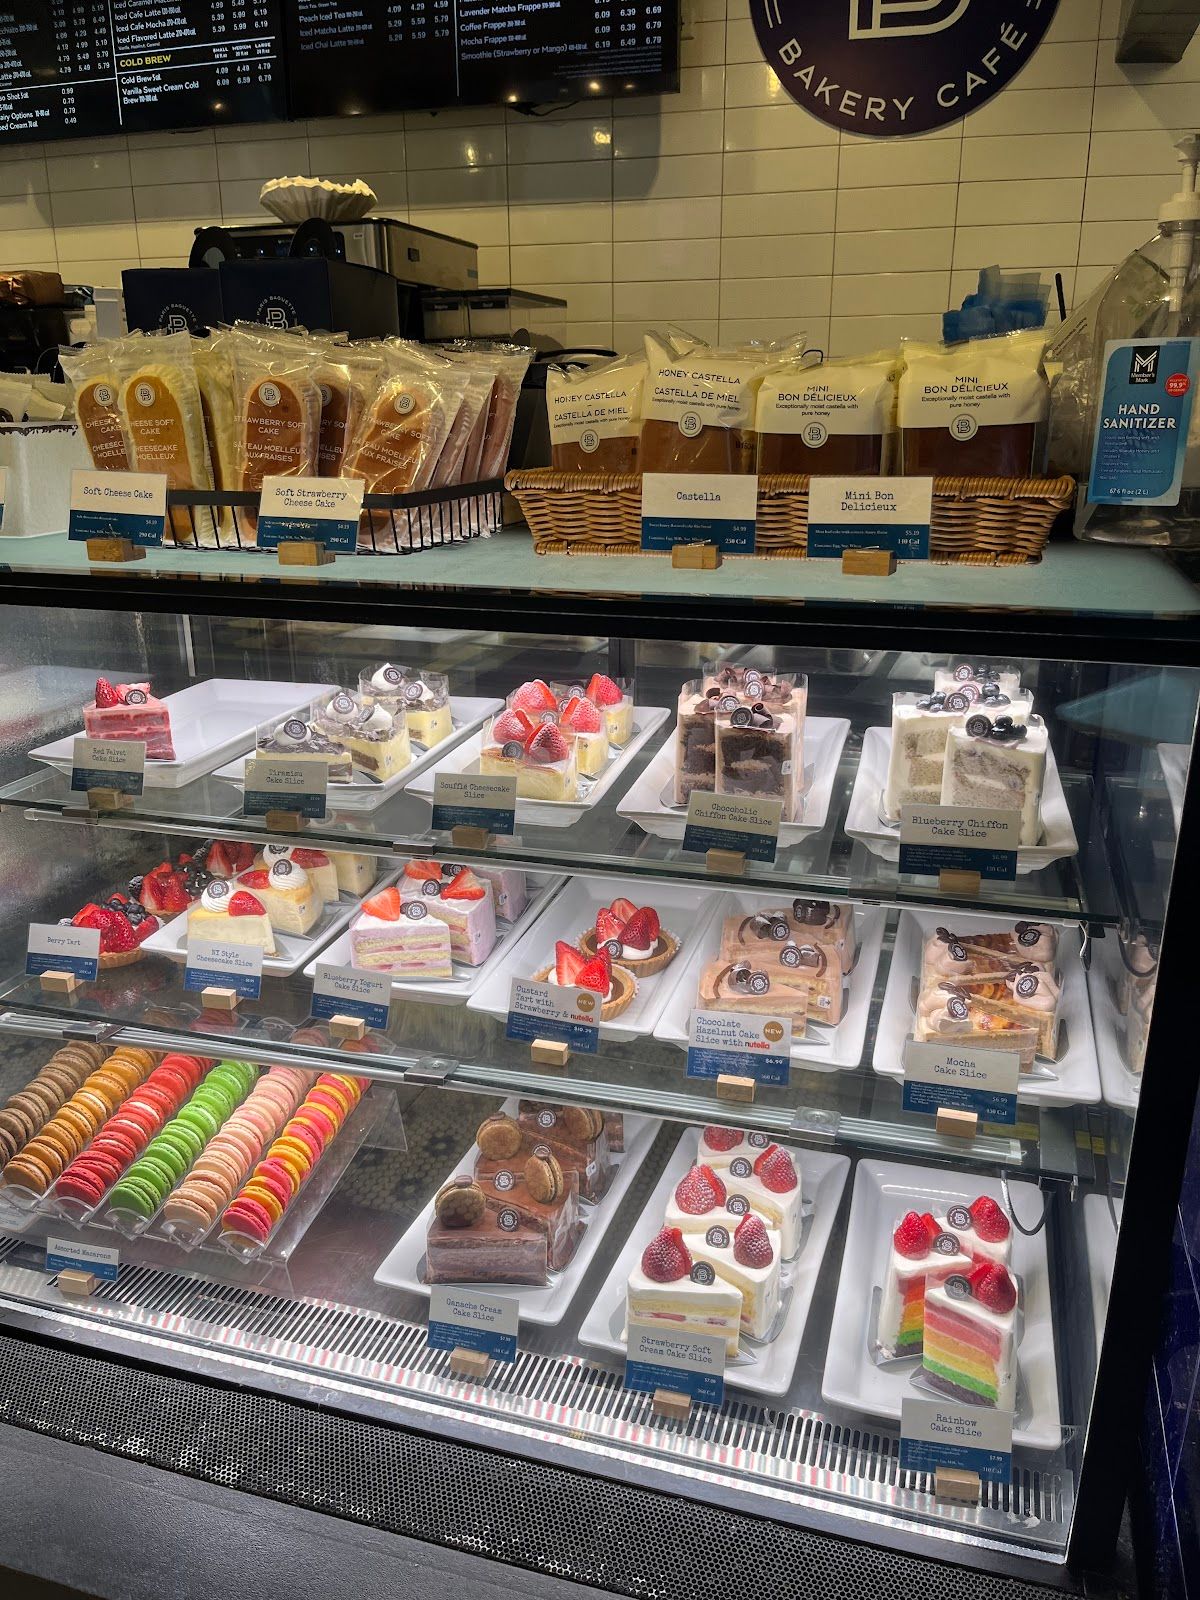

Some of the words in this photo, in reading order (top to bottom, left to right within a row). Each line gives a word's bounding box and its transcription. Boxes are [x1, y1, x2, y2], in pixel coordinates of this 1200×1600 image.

[115, 12, 127, 20] Iced
[144, 10, 161, 18] Latte
[460, 8, 490, 18] Lavender
[492, 5, 516, 14] Matcha
[518, 4, 540, 13] Frappe
[594, 11, 610, 19] 6.09
[620, 8, 636, 16] 6.39
[646, 6, 661, 14] 6.69
[116, 24, 128, 32] Iced
[146, 20, 166, 28] Mocha
[460, 22, 482, 32] Coffee
[484, 21, 506, 30] Frappe
[595, 26, 610, 34] 6.09
[620, 24, 636, 32] 6.39
[646, 22, 661, 30] 6.79
[117, 36, 130, 44] Iced
[132, 32, 157, 42] Flavored
[158, 32, 176, 40] Latte
[460, 38, 482, 46] Mocha
[484, 36, 508, 44] Frappe
[595, 40, 610, 48] 6.19
[620, 38, 636, 46] 6.49
[646, 36, 661, 44] 6.79
[461, 51, 492, 60] Smoothie
[494, 48, 531, 58] (Strawberry
[542, 44, 568, 54] Mango)
[120, 58, 144, 67] COLD
[145, 54, 172, 65] BREW
[778, 38, 914, 121] BAKERY
[936, 22, 1028, 108] CAFÉ
[121, 76, 135, 84] Cold
[136, 75, 152, 83] Brew
[122, 86, 142, 96] Vanilla
[143, 86, 162, 94] Sweet
[164, 84, 184, 92] Cream
[184, 81, 199, 90] Cold
[123, 96, 138, 104] Brew
[659, 369, 690, 378] HONEY
[691, 372, 741, 385] CASTELLA
[955, 376, 978, 384] MINI
[924, 386, 948, 394] BON
[952, 382, 1008, 393] DÉLICIEUX
[554, 394, 582, 404] HONEY
[584, 391, 627, 401] CASTELLA
[654, 388, 698, 398] CASTELLA
[701, 392, 714, 400] DE
[717, 394, 740, 403] MIEL
[803, 392, 857, 402] DÉLICIEUX
[554, 411, 592, 421] CASTELLA
[608, 406, 628, 415] MIEL
[1118, 403, 1160, 414] HAND
[155, 418, 174, 426] SOFT
[234, 415, 286, 427] STRAWBERRY
[287, 421, 307, 430] SOFT
[1103, 418, 1176, 428] SANITIZER
[258, 427, 280, 435] CAKE
[264, 444, 306, 456] MOELLEUX
[83, 486, 102, 496] Soft
[104, 488, 131, 497] Cheese
[134, 490, 153, 499] Cake
[276, 488, 295, 496] Soft
[296, 489, 348, 500] Strawberry
[676, 492, 721, 501] Castella
[845, 491, 872, 500] Mini
[875, 491, 894, 500] Bon
[284, 498, 312, 507] Cheese
[316, 500, 336, 508] Cake
[841, 502, 897, 511] Delicieux
[441, 782, 467, 790] Souffle
[470, 784, 510, 792] Cheesecake
[712, 804, 758, 816] Chocoholic
[695, 809, 726, 820] Chiffon
[729, 814, 747, 822] Cake
[749, 817, 772, 825] Slice
[912, 816, 964, 828] Blueberry
[968, 820, 1008, 830] Chiffon
[932, 827, 955, 836] Cake
[958, 829, 987, 838] Slice
[48, 936, 66, 945] Berry
[197, 955, 233, 964] Cheesecake
[324, 973, 358, 984] Blueberry
[360, 979, 383, 988] Yogurt
[334, 982, 350, 990] Cake
[516, 986, 548, 997] Custard
[516, 994, 534, 1003] Tart
[536, 998, 554, 1007] with
[515, 1002, 560, 1018] Strawberry
[570, 1014, 593, 1022] nutella
[696, 1017, 741, 1028] Chocolate
[696, 1026, 736, 1037] Hazelnut
[739, 1030, 760, 1039] Cake
[695, 1035, 720, 1045] Slice
[722, 1038, 744, 1046] with
[745, 1042, 770, 1050] nutella
[946, 1057, 976, 1068] Mocha
[934, 1065, 957, 1075] Cake
[960, 1068, 988, 1079] Slice
[447, 1298, 477, 1309] Ganache
[480, 1304, 503, 1314] Cream
[453, 1308, 470, 1316] Cake
[472, 1312, 494, 1321] Slice
[641, 1336, 690, 1352] Strawberry
[693, 1345, 712, 1354] Soft
[640, 1345, 665, 1355] Cream
[667, 1349, 686, 1358] Cake
[688, 1353, 712, 1363] Slice
[936, 1414, 977, 1426] Rainbow
[930, 1423, 952, 1432] Cake
[955, 1427, 982, 1437] Slice
